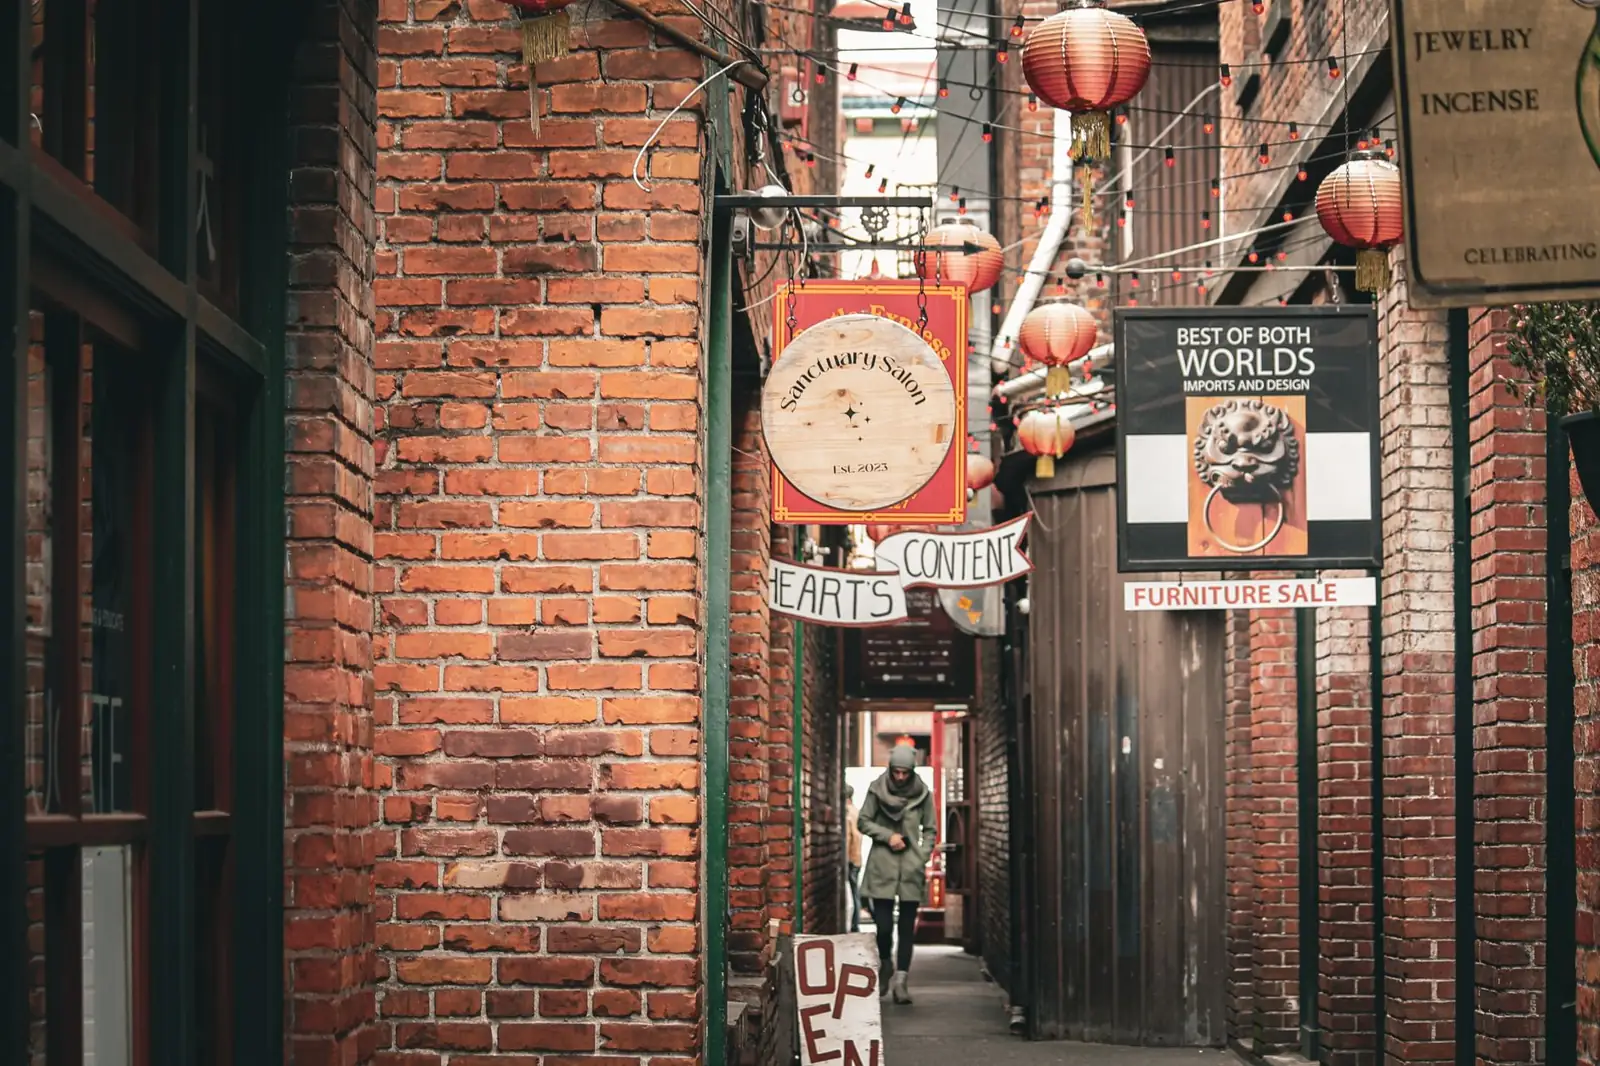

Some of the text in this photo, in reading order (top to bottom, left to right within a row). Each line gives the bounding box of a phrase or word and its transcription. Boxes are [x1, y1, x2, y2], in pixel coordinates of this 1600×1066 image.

[1413, 28, 1532, 61] JEWELRY
[1420, 89, 1539, 115] INCENSE
[1464, 243, 1597, 264] CELEBRATING
[1177, 327, 1311, 345] BEST OF BOTH
[1177, 348, 1316, 376] WORLDS
[780, 352, 926, 413] Sanctuary Salon
[1183, 379, 1310, 392] IMPORTS AND DESIGN
[858, 463, 888, 473] 2023
[904, 533, 1016, 581] CONTENT
[1134, 583, 1337, 606] FURNITURE SALE
